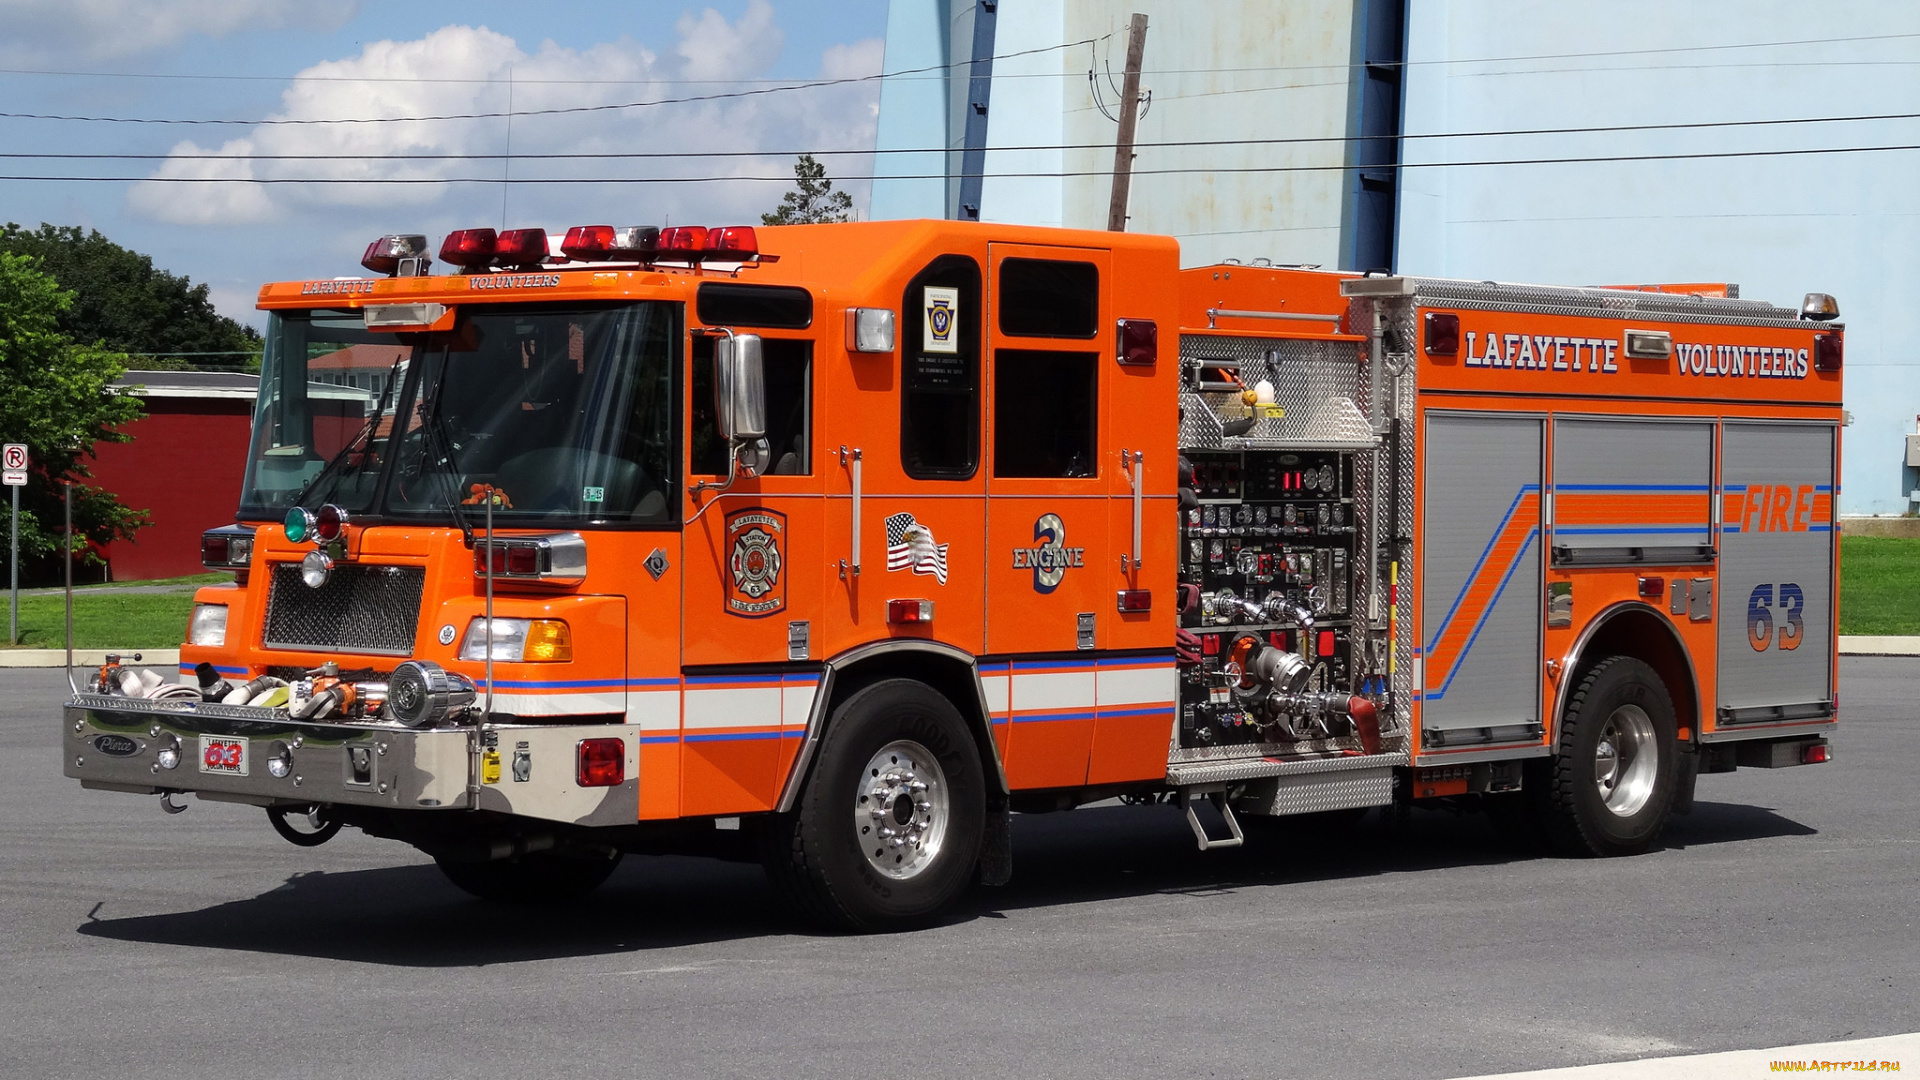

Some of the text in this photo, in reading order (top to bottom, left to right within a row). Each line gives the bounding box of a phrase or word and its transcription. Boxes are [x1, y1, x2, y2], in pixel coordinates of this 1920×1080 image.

[301, 274, 562, 295] LAFAYETTE VOLUNTEERS
[1465, 331, 1808, 379] LAFAYETTE VOLUNTEERS
[738, 514, 774, 525] LAFAYETTE
[1741, 484, 1815, 533] FIRE
[745, 534, 767, 543] STATION
[1012, 547, 1085, 570] ENGINE
[1033, 512, 1066, 595] 3
[750, 585, 761, 594] 63
[1747, 583, 1804, 652] 63
[100, 736, 132, 751] Pierce
